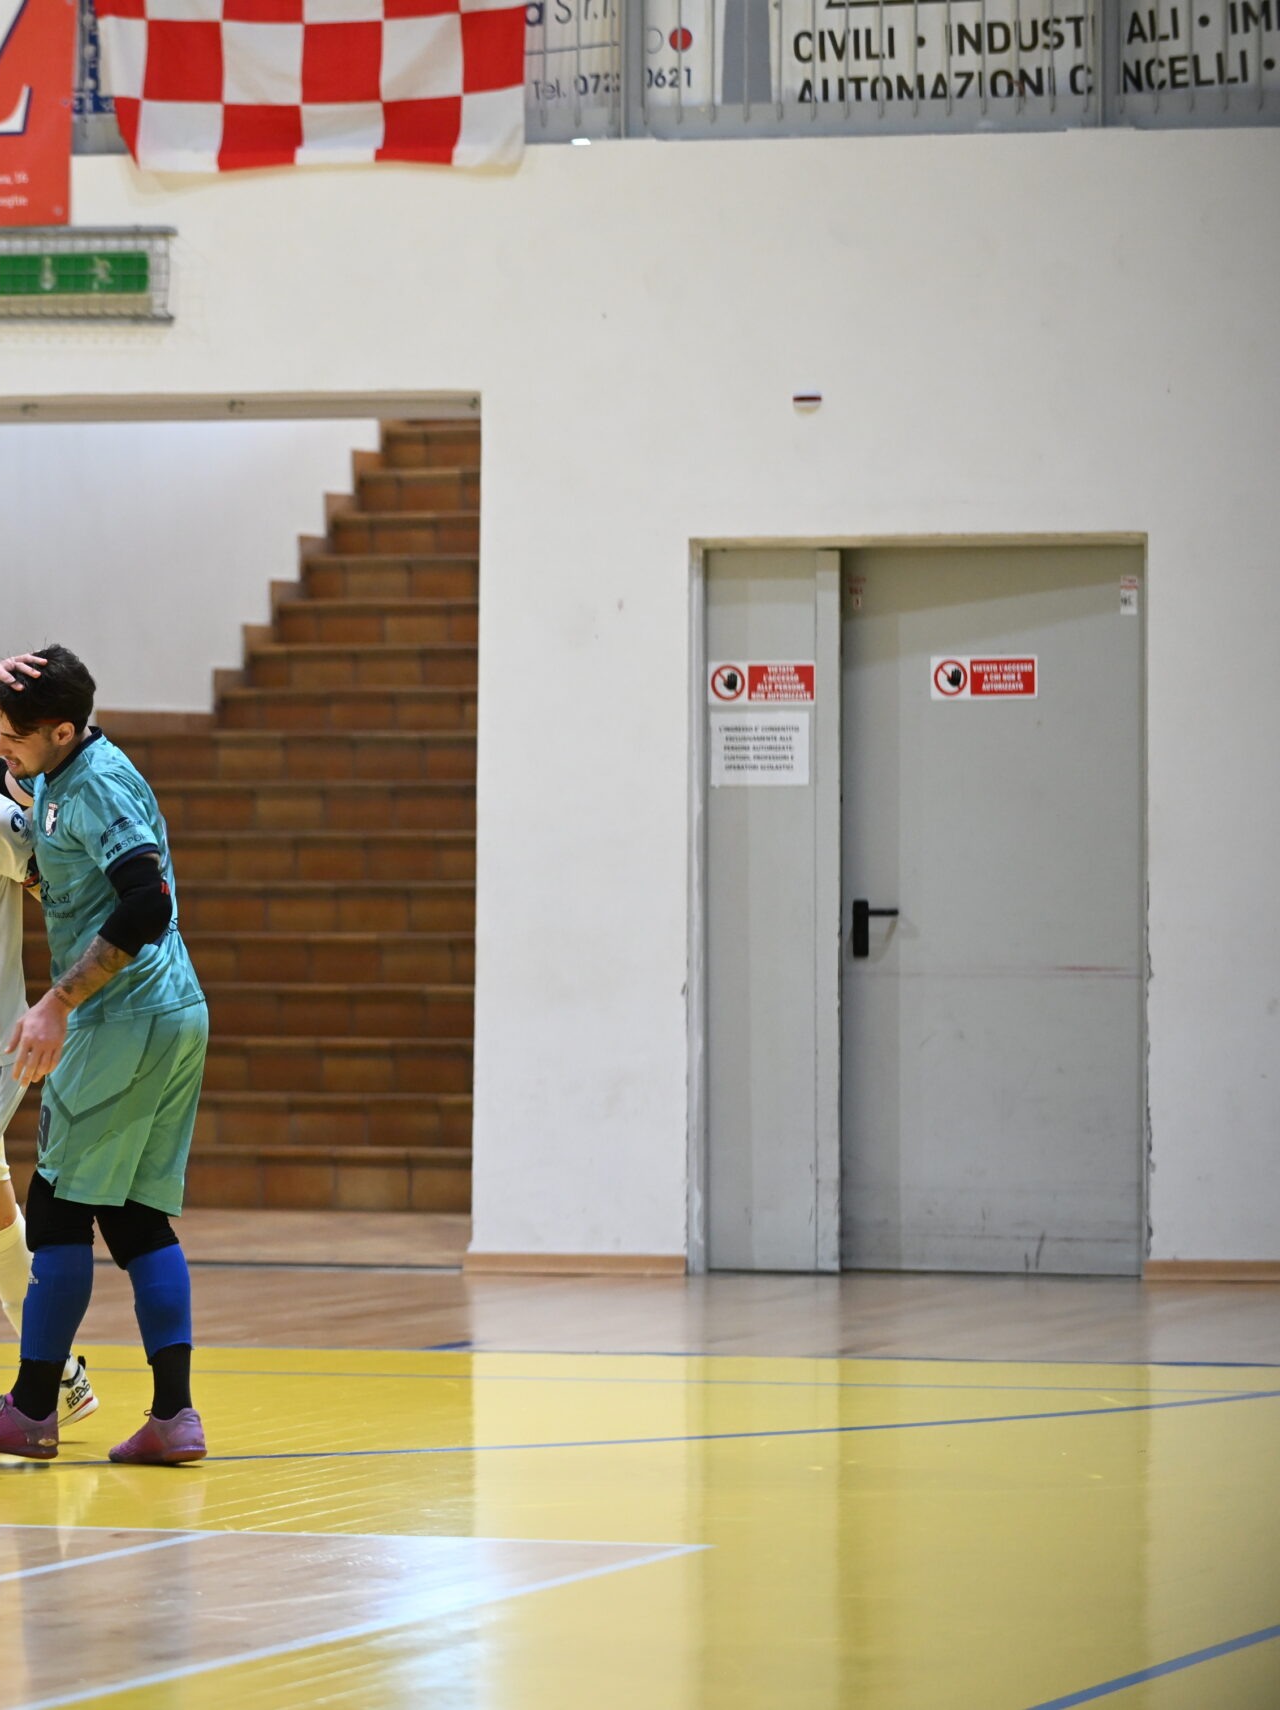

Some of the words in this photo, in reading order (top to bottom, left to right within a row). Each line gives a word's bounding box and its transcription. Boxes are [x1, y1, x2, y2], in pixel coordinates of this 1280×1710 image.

[793, 25, 895, 63] CIVILI
[1229, 1, 1280, 35] IM
[797, 67, 1056, 103] AUTOMAZIONI
[767, 665, 795, 673] VIETATO
[972, 663, 998, 672] VIETATO
[999, 662, 1032, 672] L'ACCESSO
[982, 681, 1024, 691] AUTORIZZATO
